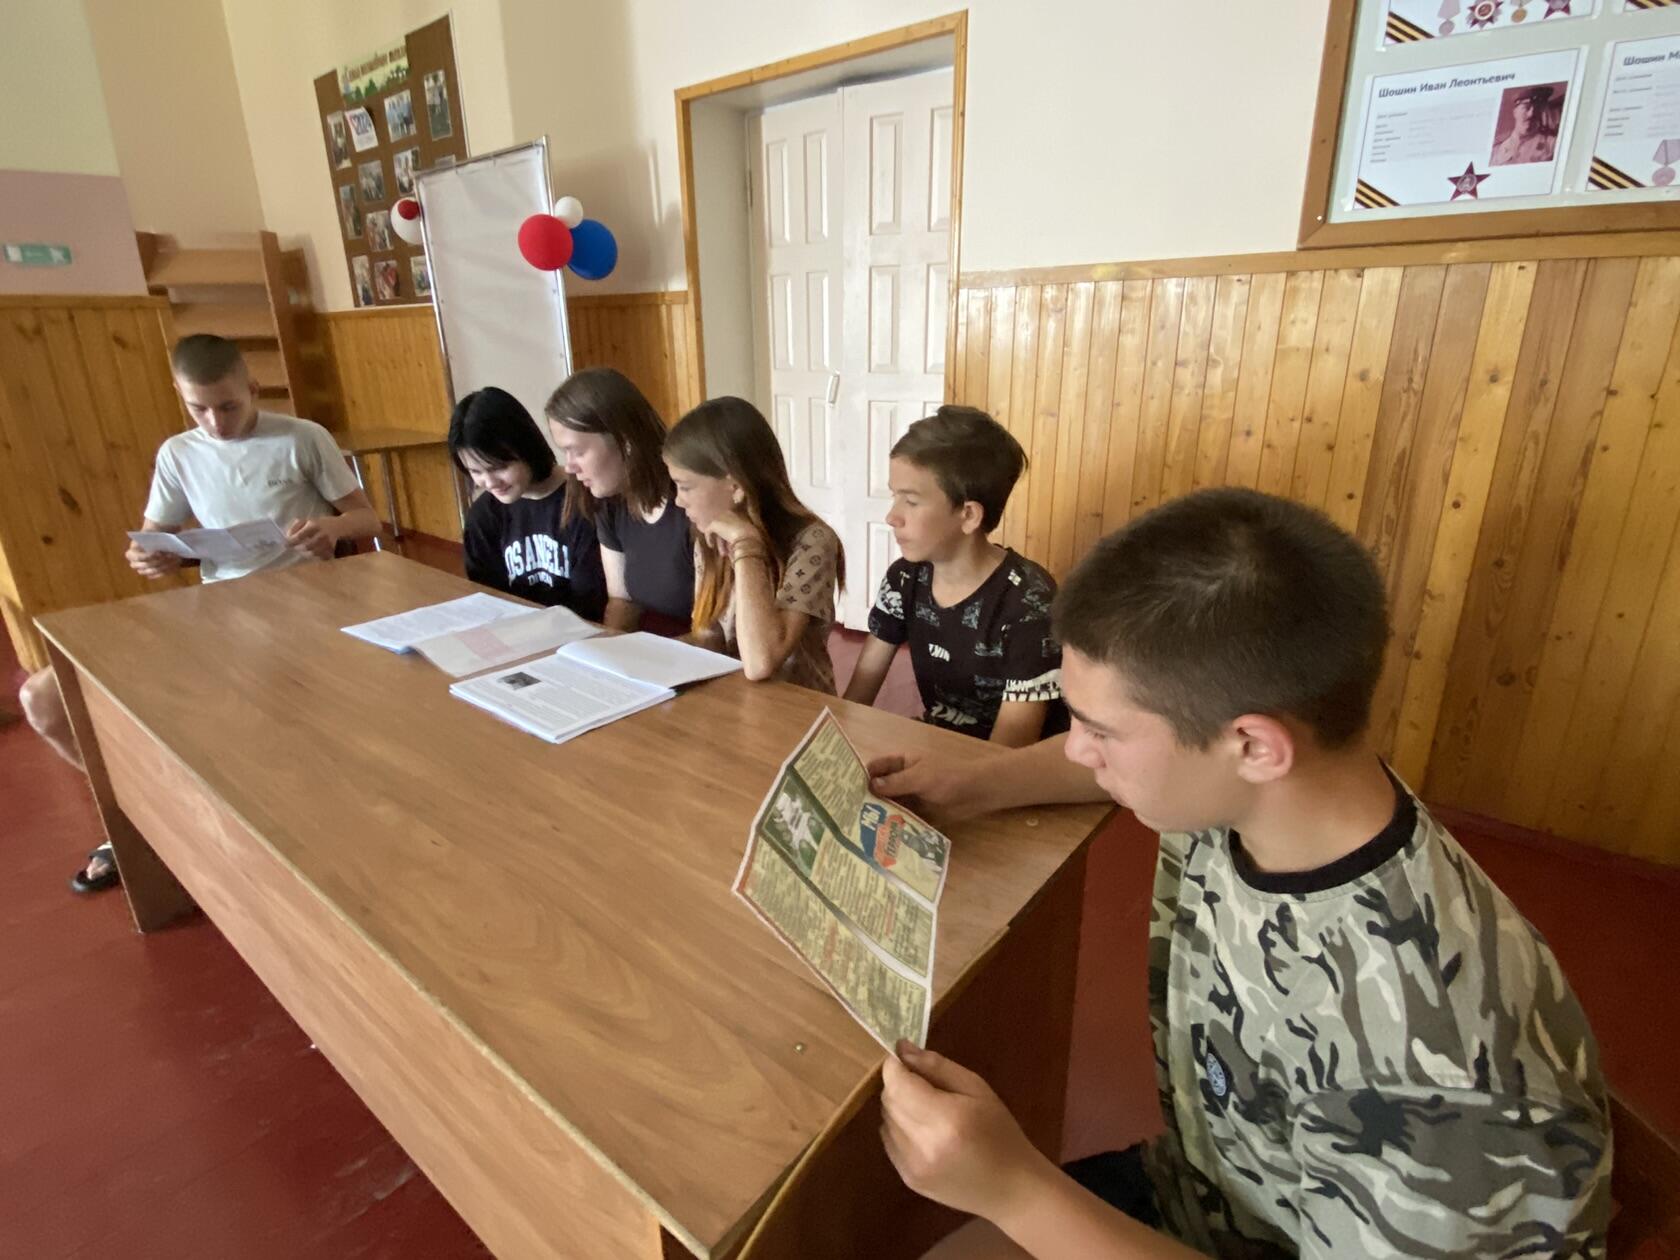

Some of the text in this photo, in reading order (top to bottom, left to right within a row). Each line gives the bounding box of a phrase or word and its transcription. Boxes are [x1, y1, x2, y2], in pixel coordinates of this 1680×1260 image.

[1668, 51, 1680, 60] М
[1378, 73, 1516, 98] Шошин Иван Леонтьевич
